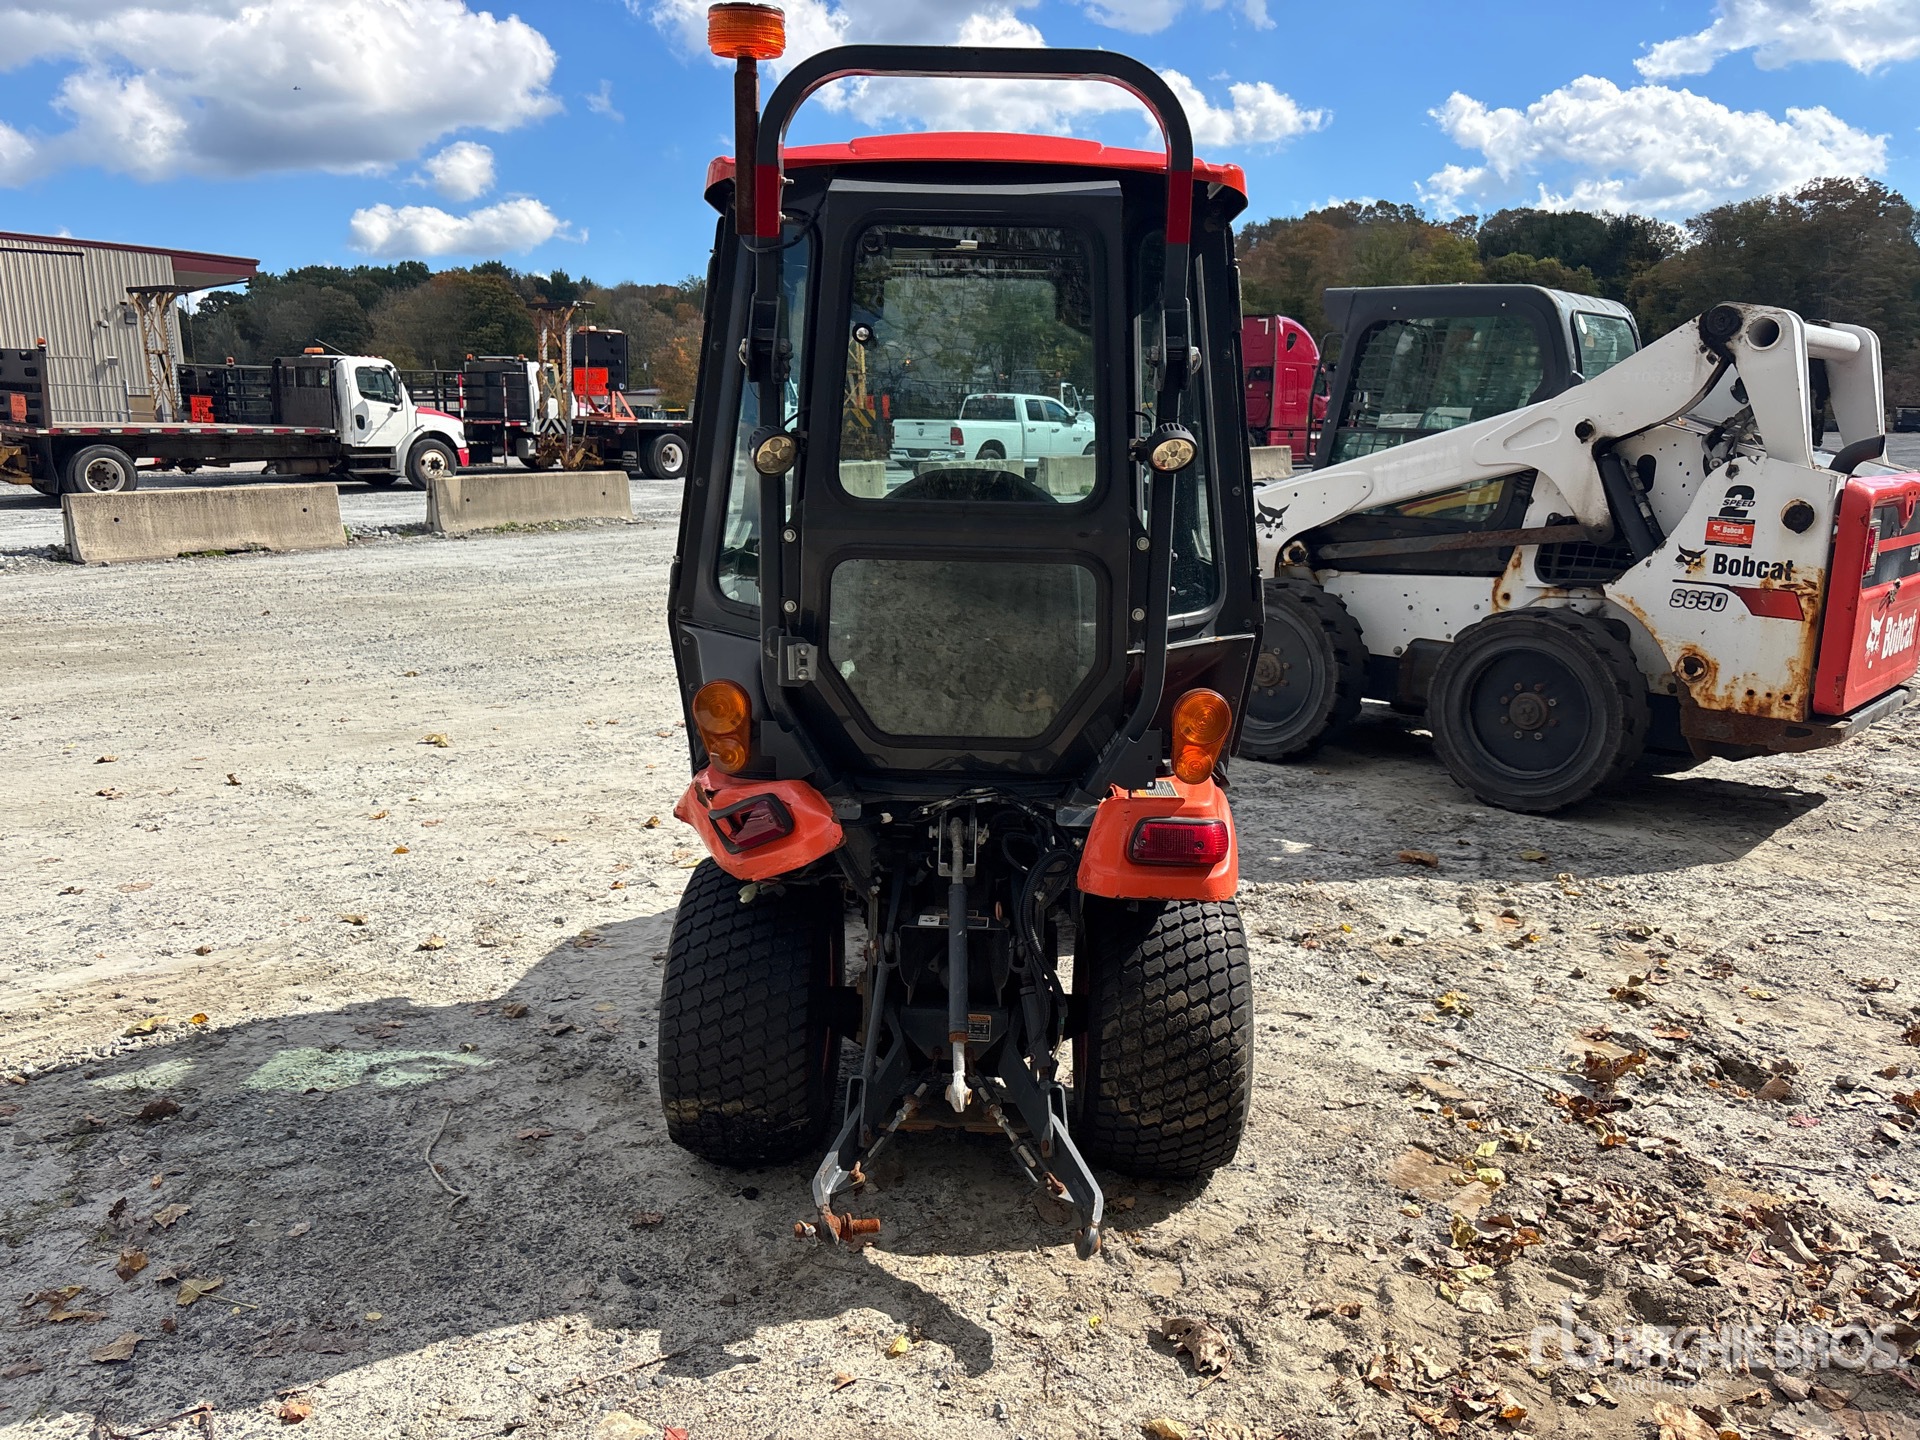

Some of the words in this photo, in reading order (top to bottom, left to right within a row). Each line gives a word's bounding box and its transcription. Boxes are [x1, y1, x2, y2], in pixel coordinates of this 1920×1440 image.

[1718, 484, 1755, 518] 2
[1722, 498, 1756, 508] SPEED
[1711, 552, 1795, 582] Bobcat
[1669, 588, 1729, 613] S650
[1881, 608, 1918, 660] Bobcat
